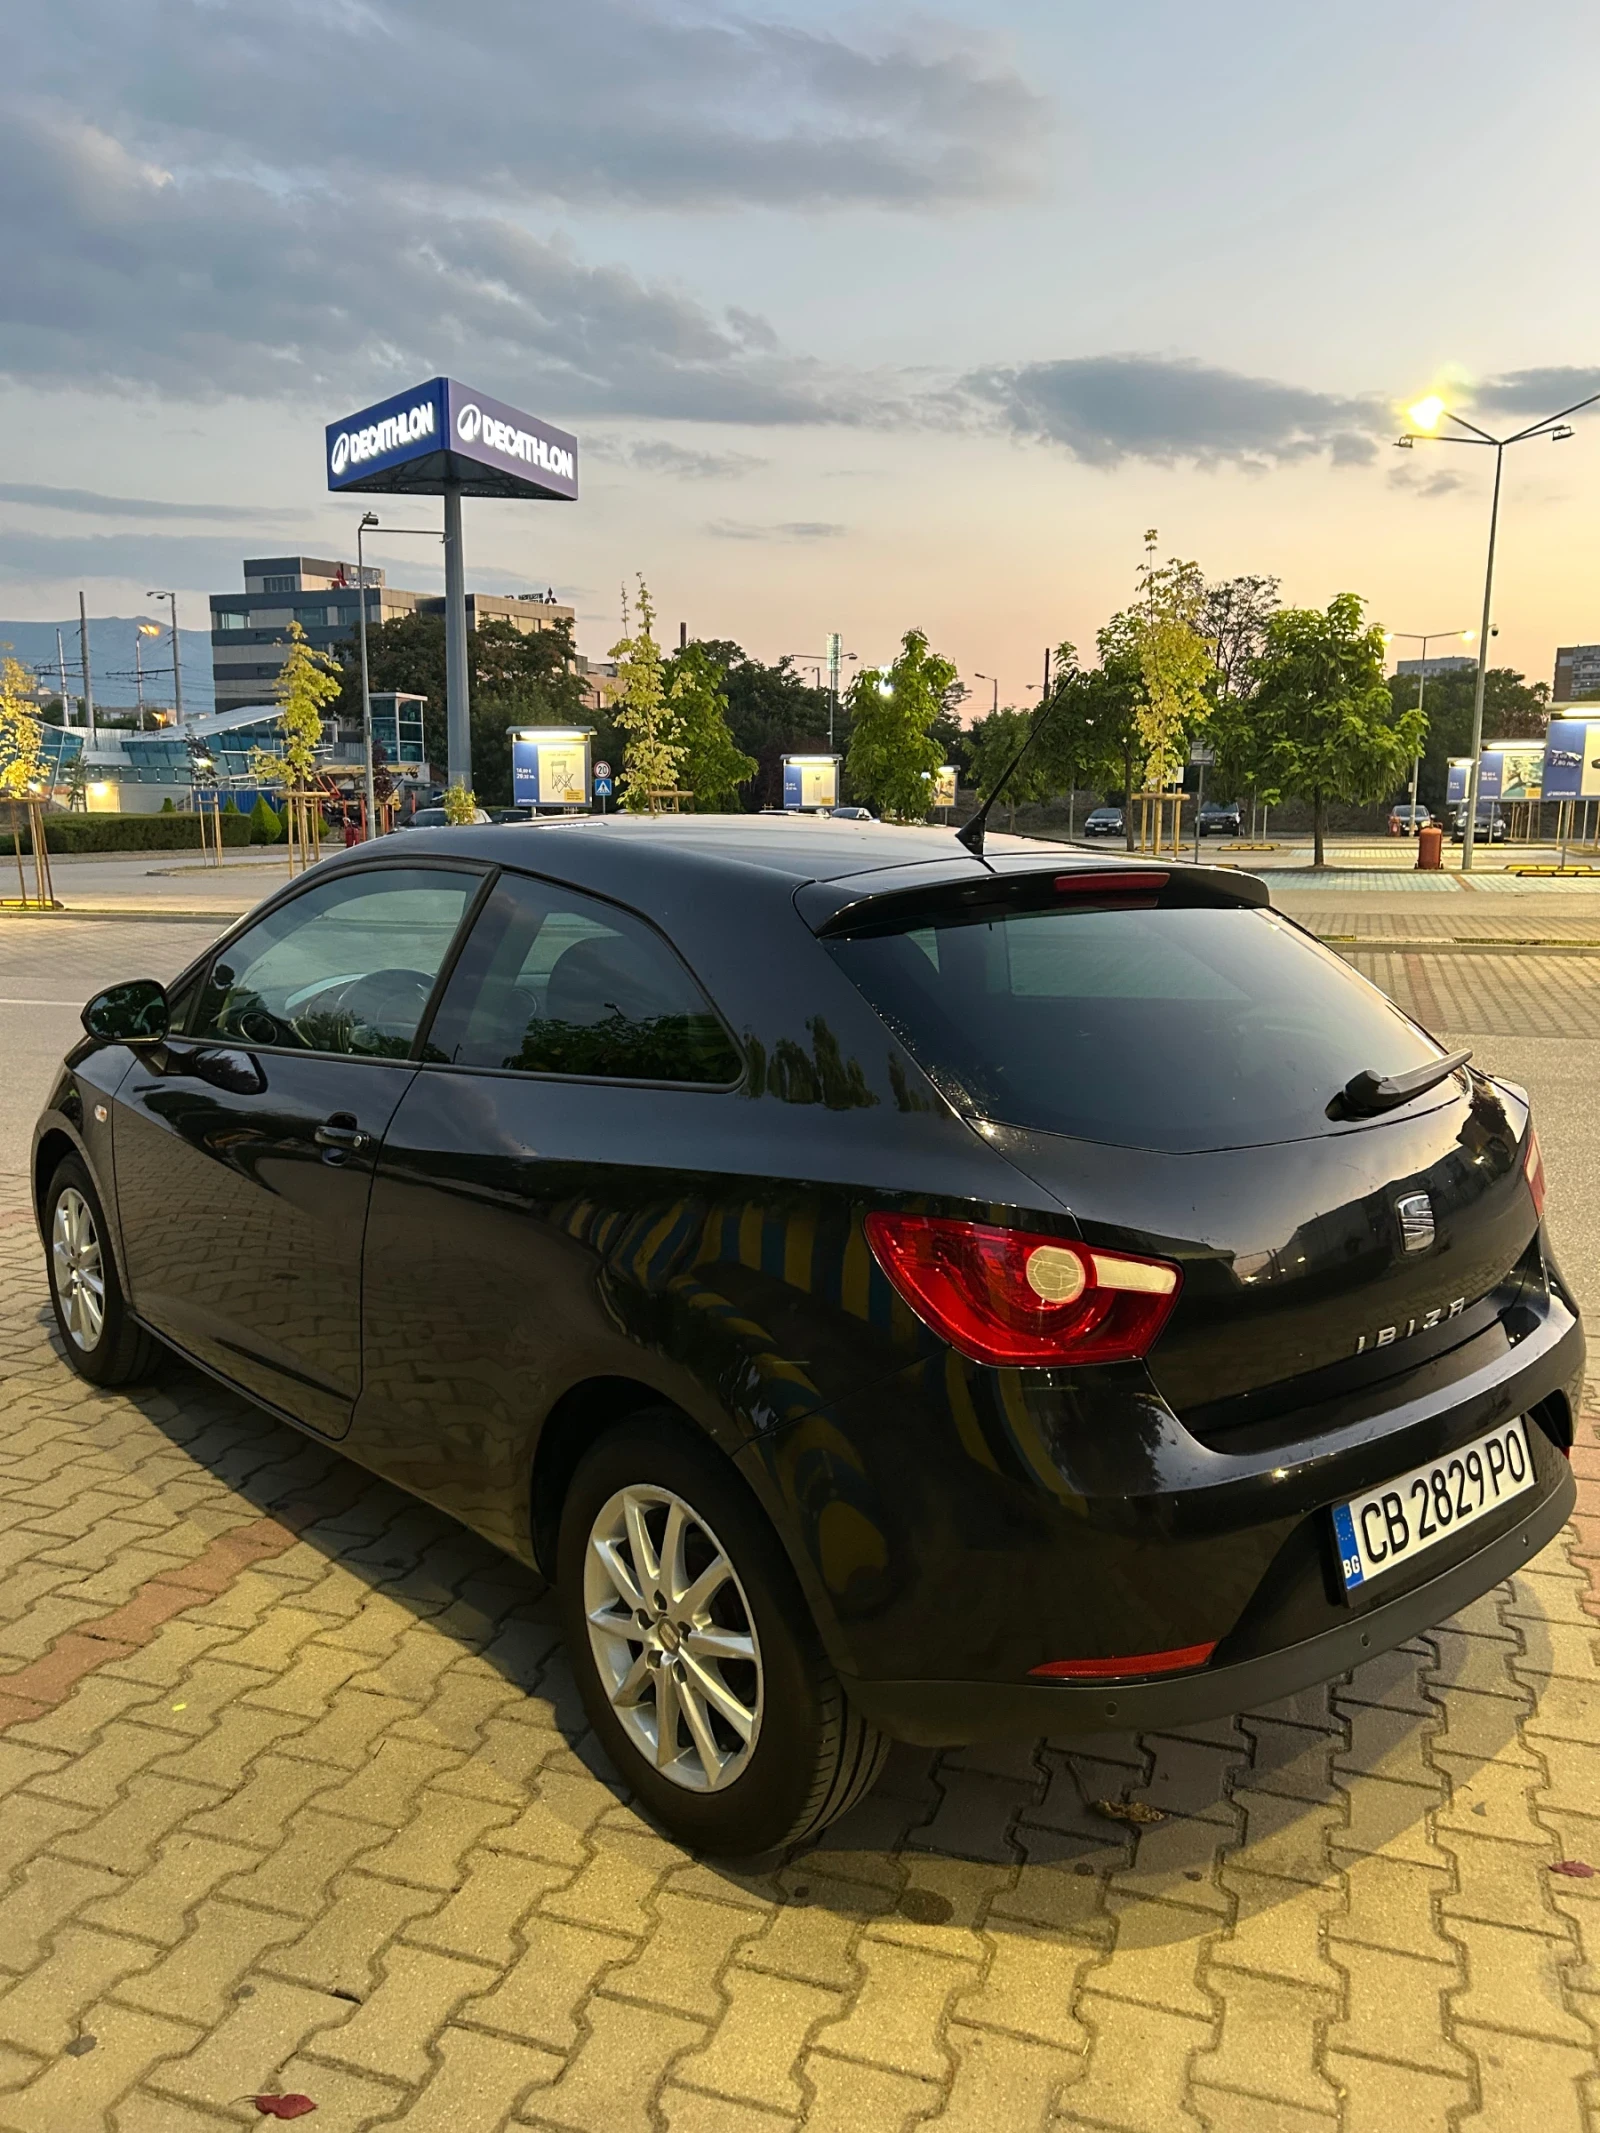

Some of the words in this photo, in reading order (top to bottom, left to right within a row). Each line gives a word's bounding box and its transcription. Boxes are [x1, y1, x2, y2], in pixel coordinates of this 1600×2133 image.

[350, 402, 434, 464] DECATHLON
[482, 414, 574, 480] DECATHLON
[598, 765, 607, 774] 20
[1356, 1297, 1465, 1354] IBIZA
[1411, 1450, 1484, 1540] 2829
[1343, 1554, 1361, 1578] BG
